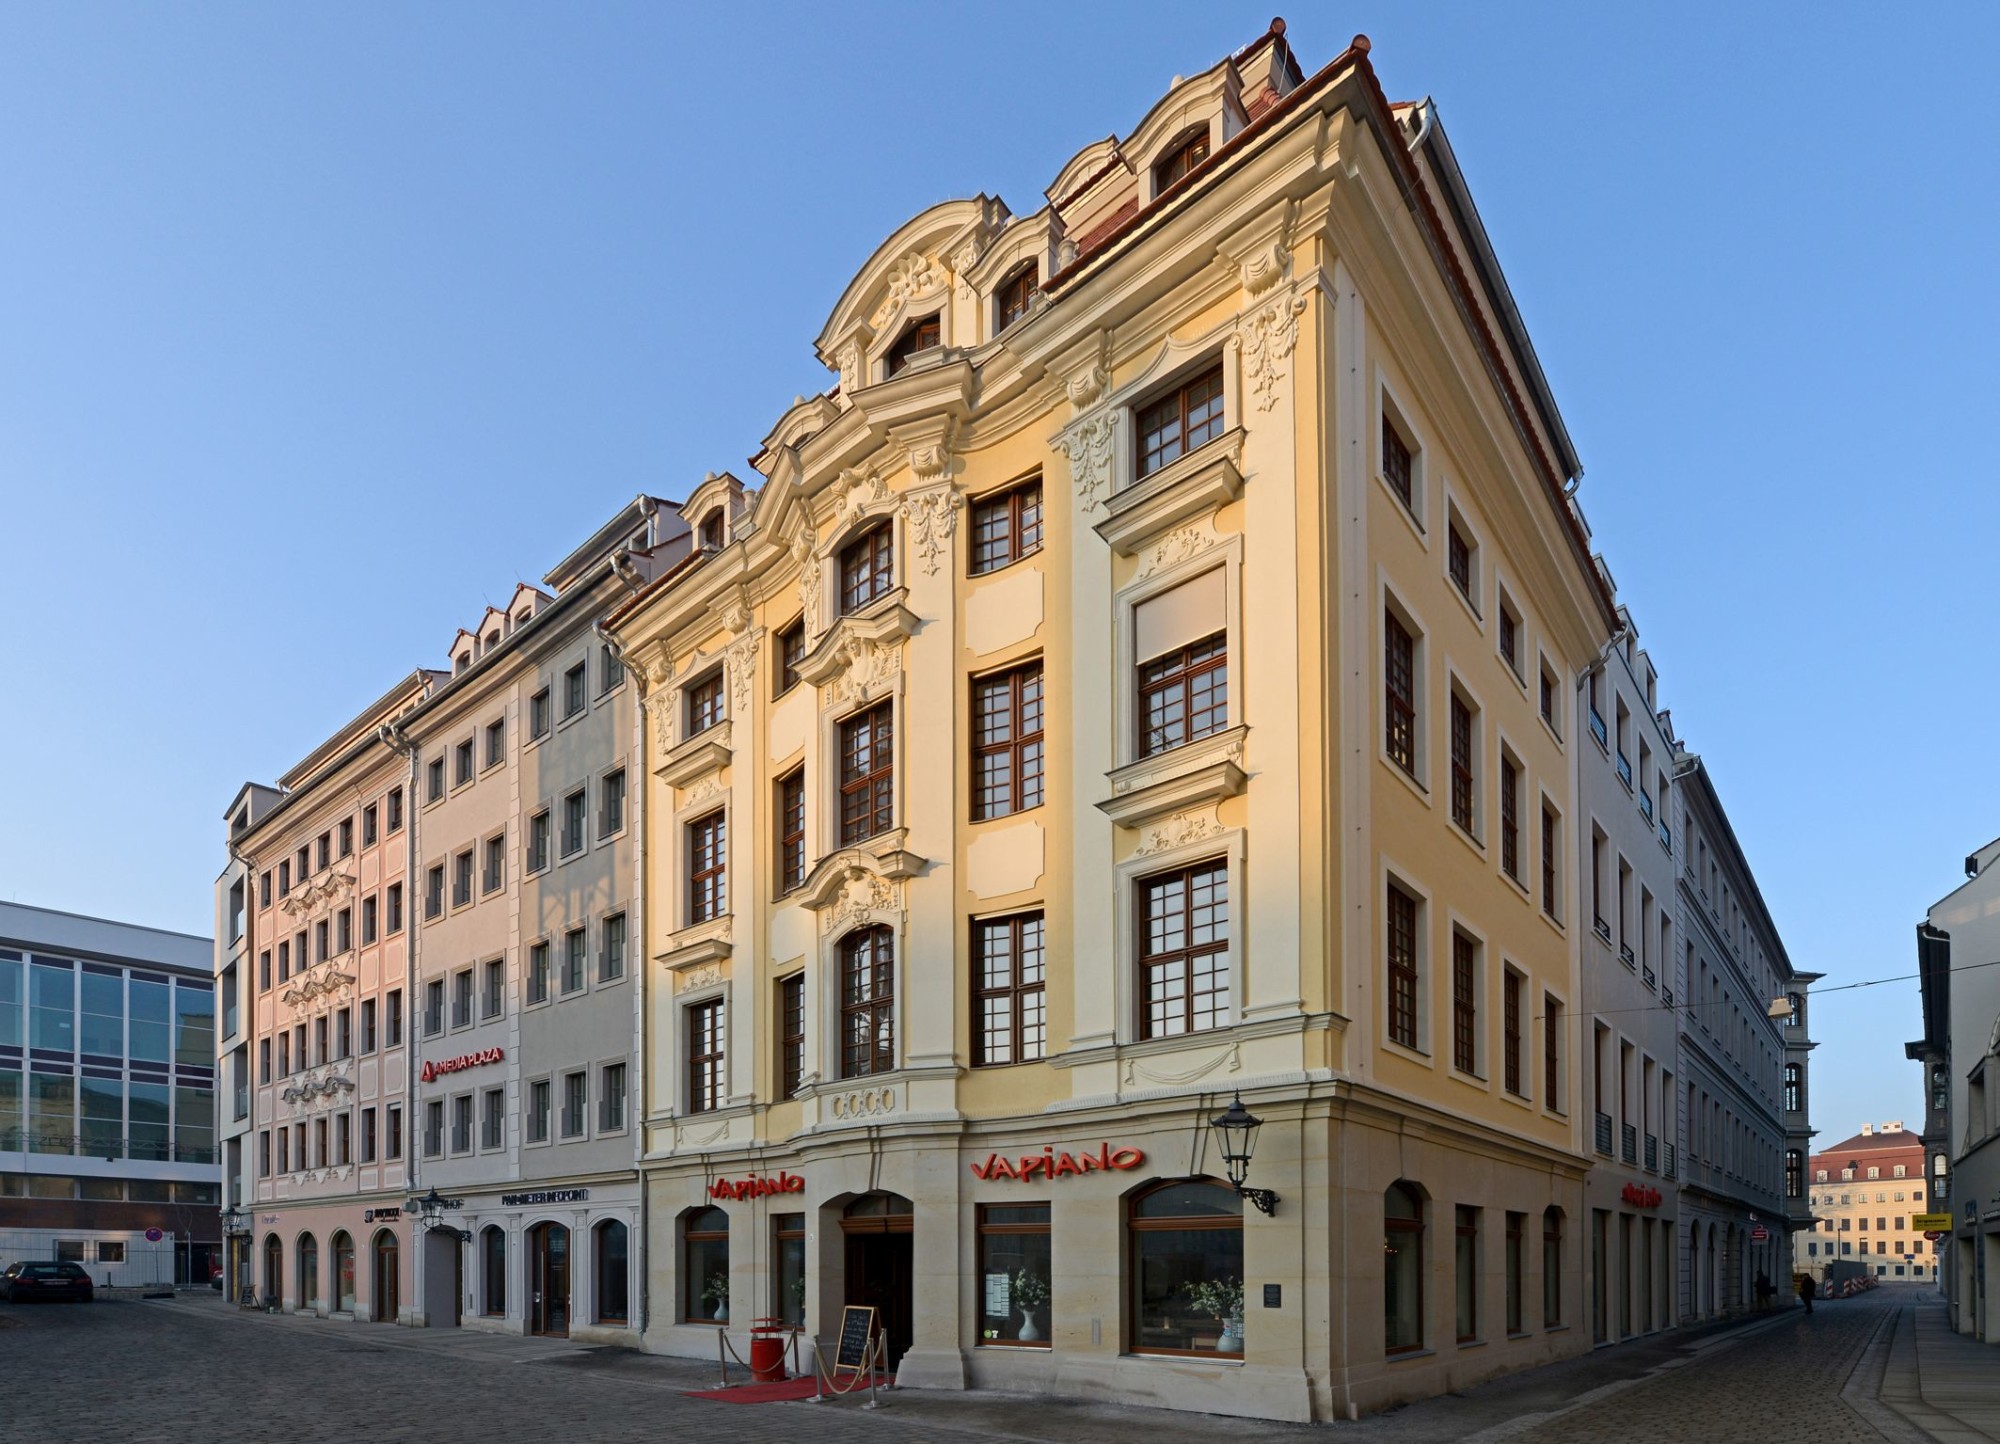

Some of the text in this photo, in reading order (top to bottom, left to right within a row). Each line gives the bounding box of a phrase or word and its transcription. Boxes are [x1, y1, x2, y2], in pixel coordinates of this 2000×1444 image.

[433, 1056, 468, 1075] AMEDIA
[467, 1047, 504, 1066] PLAZA
[970, 1142, 1146, 1183] VAPIANO
[708, 1171, 805, 1201] VAPIANO
